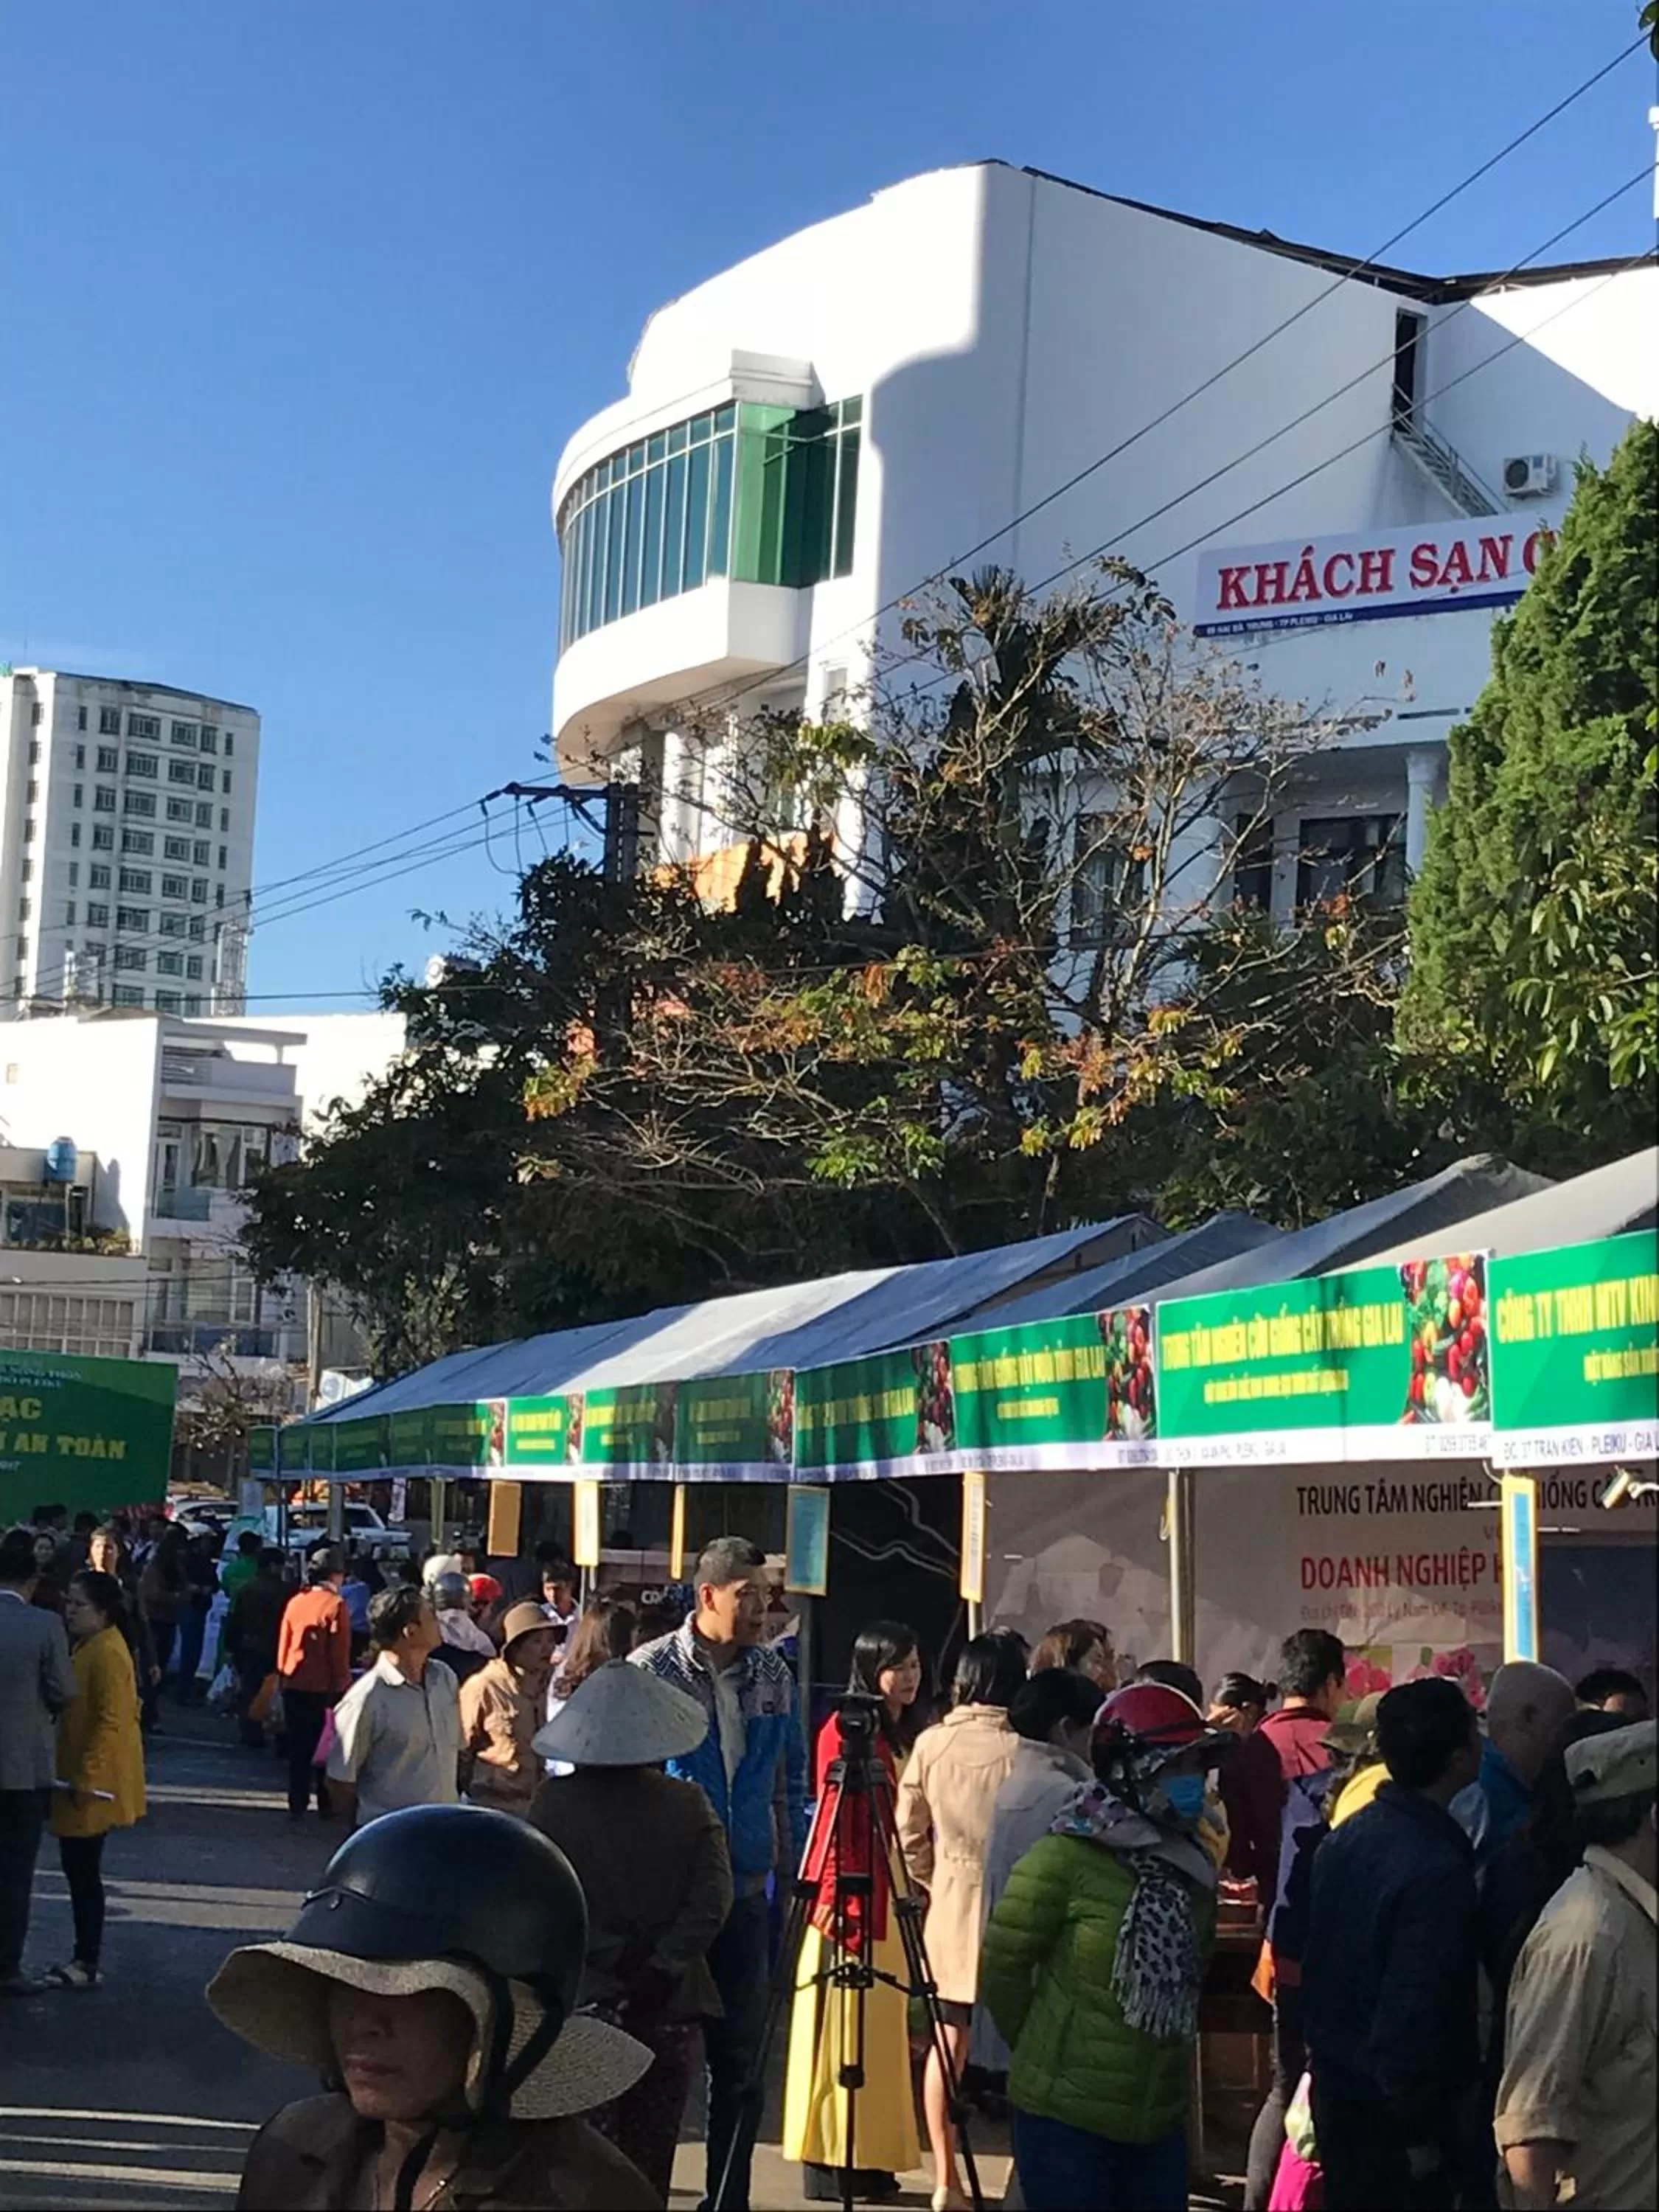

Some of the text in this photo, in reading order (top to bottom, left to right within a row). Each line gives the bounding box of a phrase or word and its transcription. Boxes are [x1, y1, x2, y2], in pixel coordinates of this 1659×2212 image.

[1217, 545, 1395, 610] KHÁCH
[1410, 535, 1514, 593] SẠN
[14, 1433, 49, 1453] AN
[56, 1433, 127, 1460] TOÀN
[1297, 1485, 1360, 1515] TRUNG
[1366, 1478, 1408, 1514] TÂM
[1412, 1476, 1482, 1512] NGHIÊN
[1541, 1469, 1587, 1509] IỐNG
[1301, 1556, 1390, 1590] DOANH
[1397, 1545, 1486, 1591] NGHIỆP
